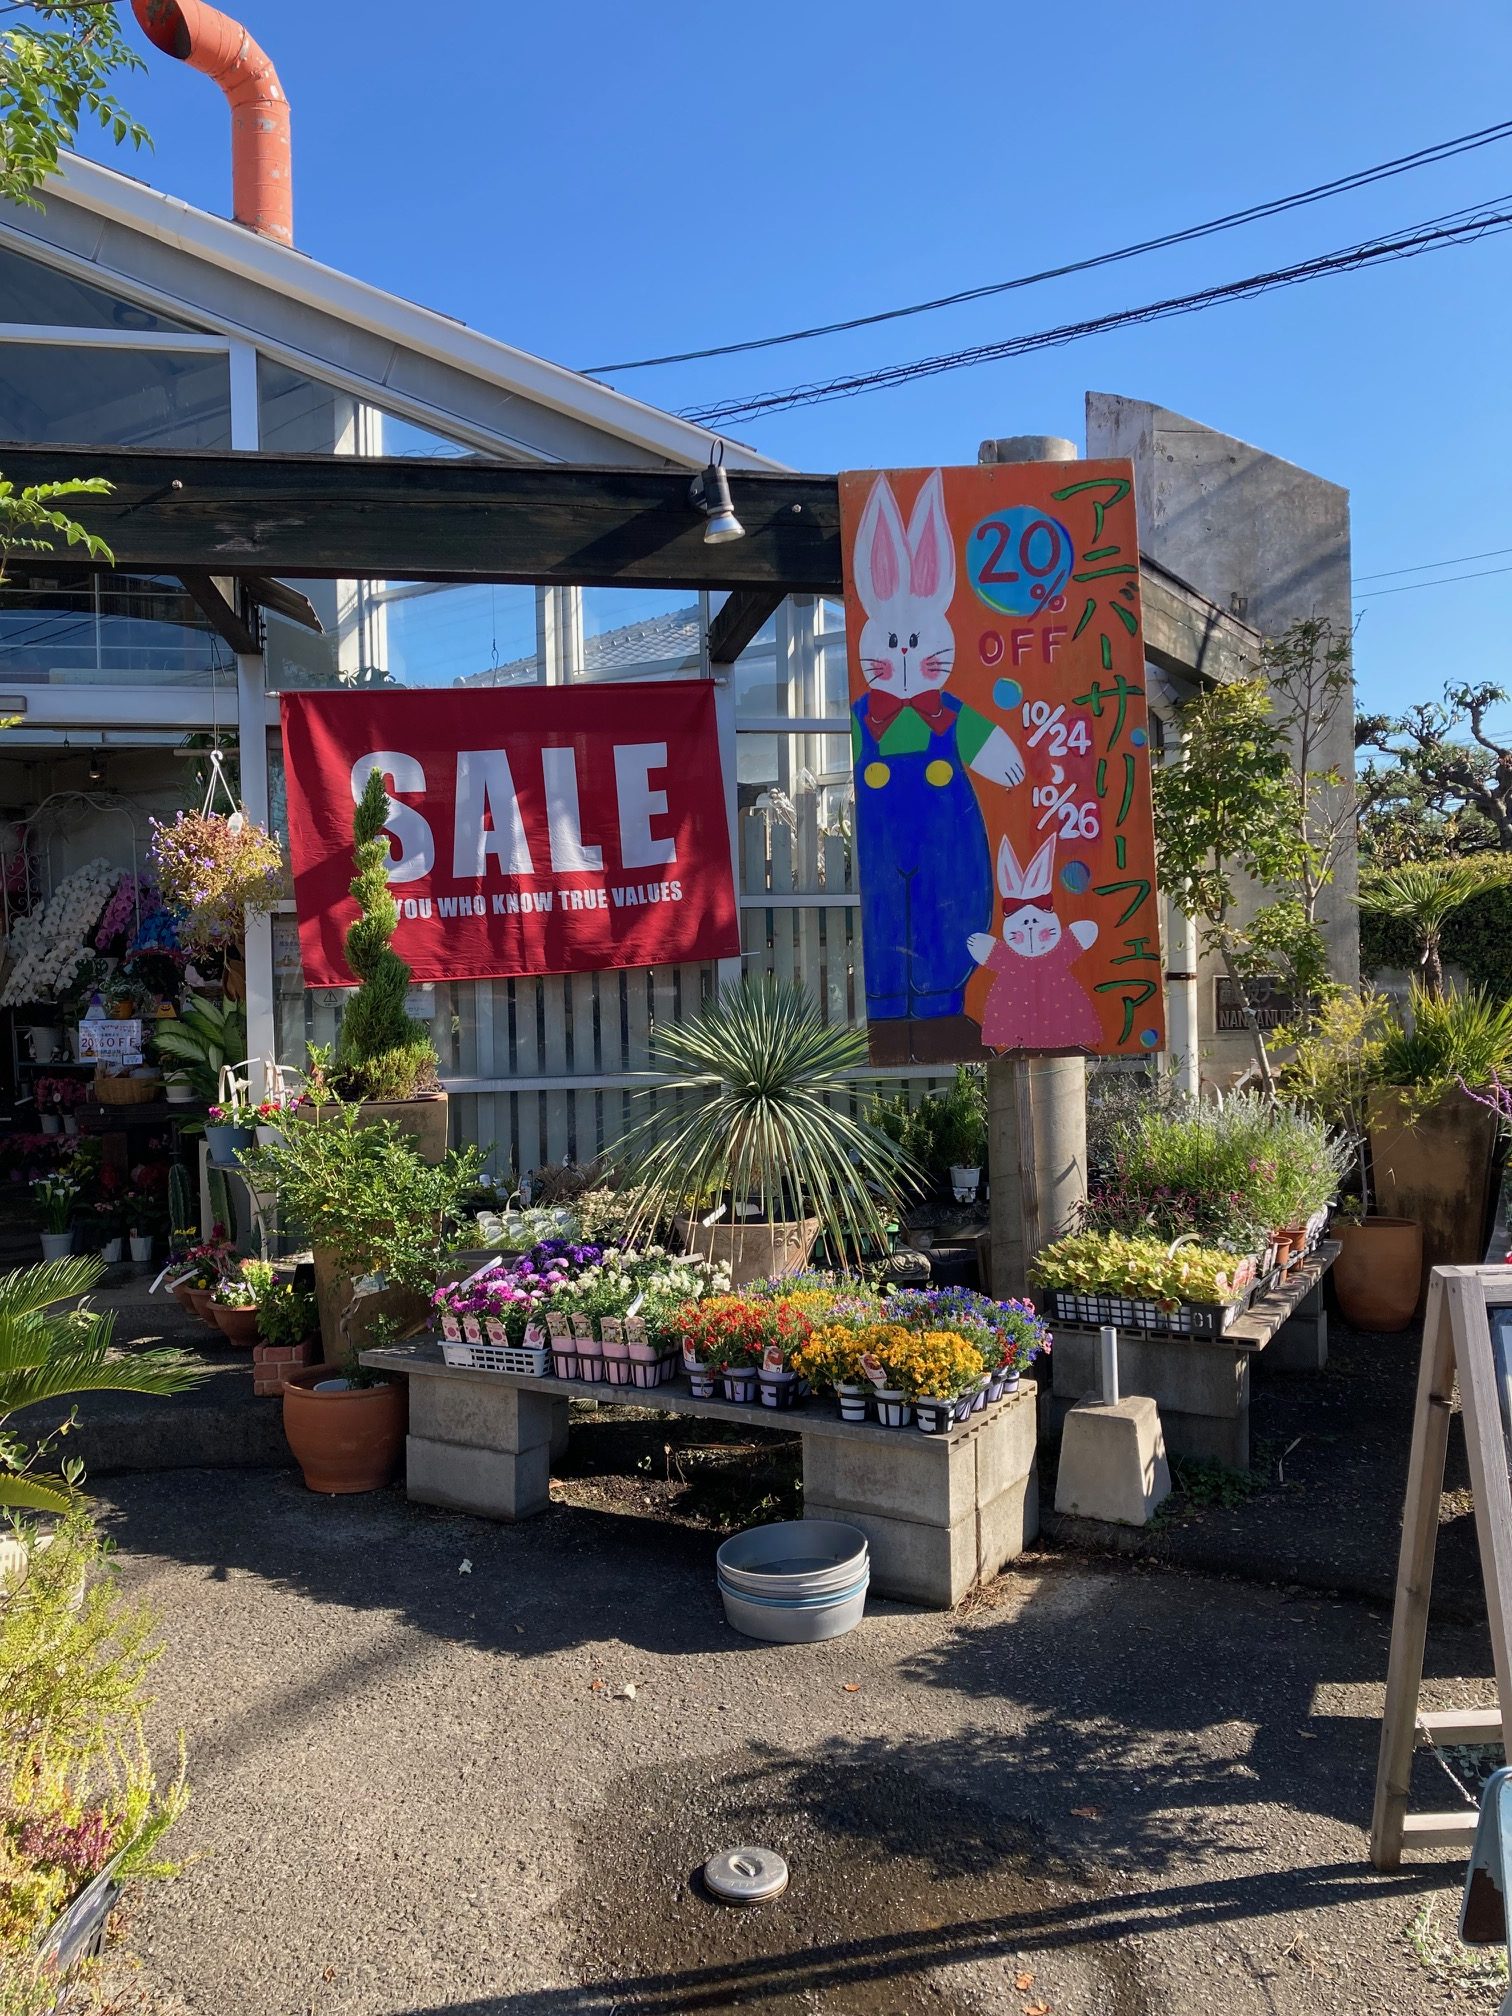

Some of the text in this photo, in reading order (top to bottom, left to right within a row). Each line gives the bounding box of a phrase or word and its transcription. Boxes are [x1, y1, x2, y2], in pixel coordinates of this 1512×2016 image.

[978, 626, 1068, 666] OFF
[1022, 700, 1091, 756] 10/24
[1052, 478, 1160, 1045] アニバーサリーフェア
[350, 741, 678, 884] SALE
[1032, 783, 1100, 841] 10/26
[437, 894, 487, 918] WHO
[492, 890, 553, 915] KNOW
[557, 886, 609, 912] TRUE
[611, 880, 683, 909] VALUES
